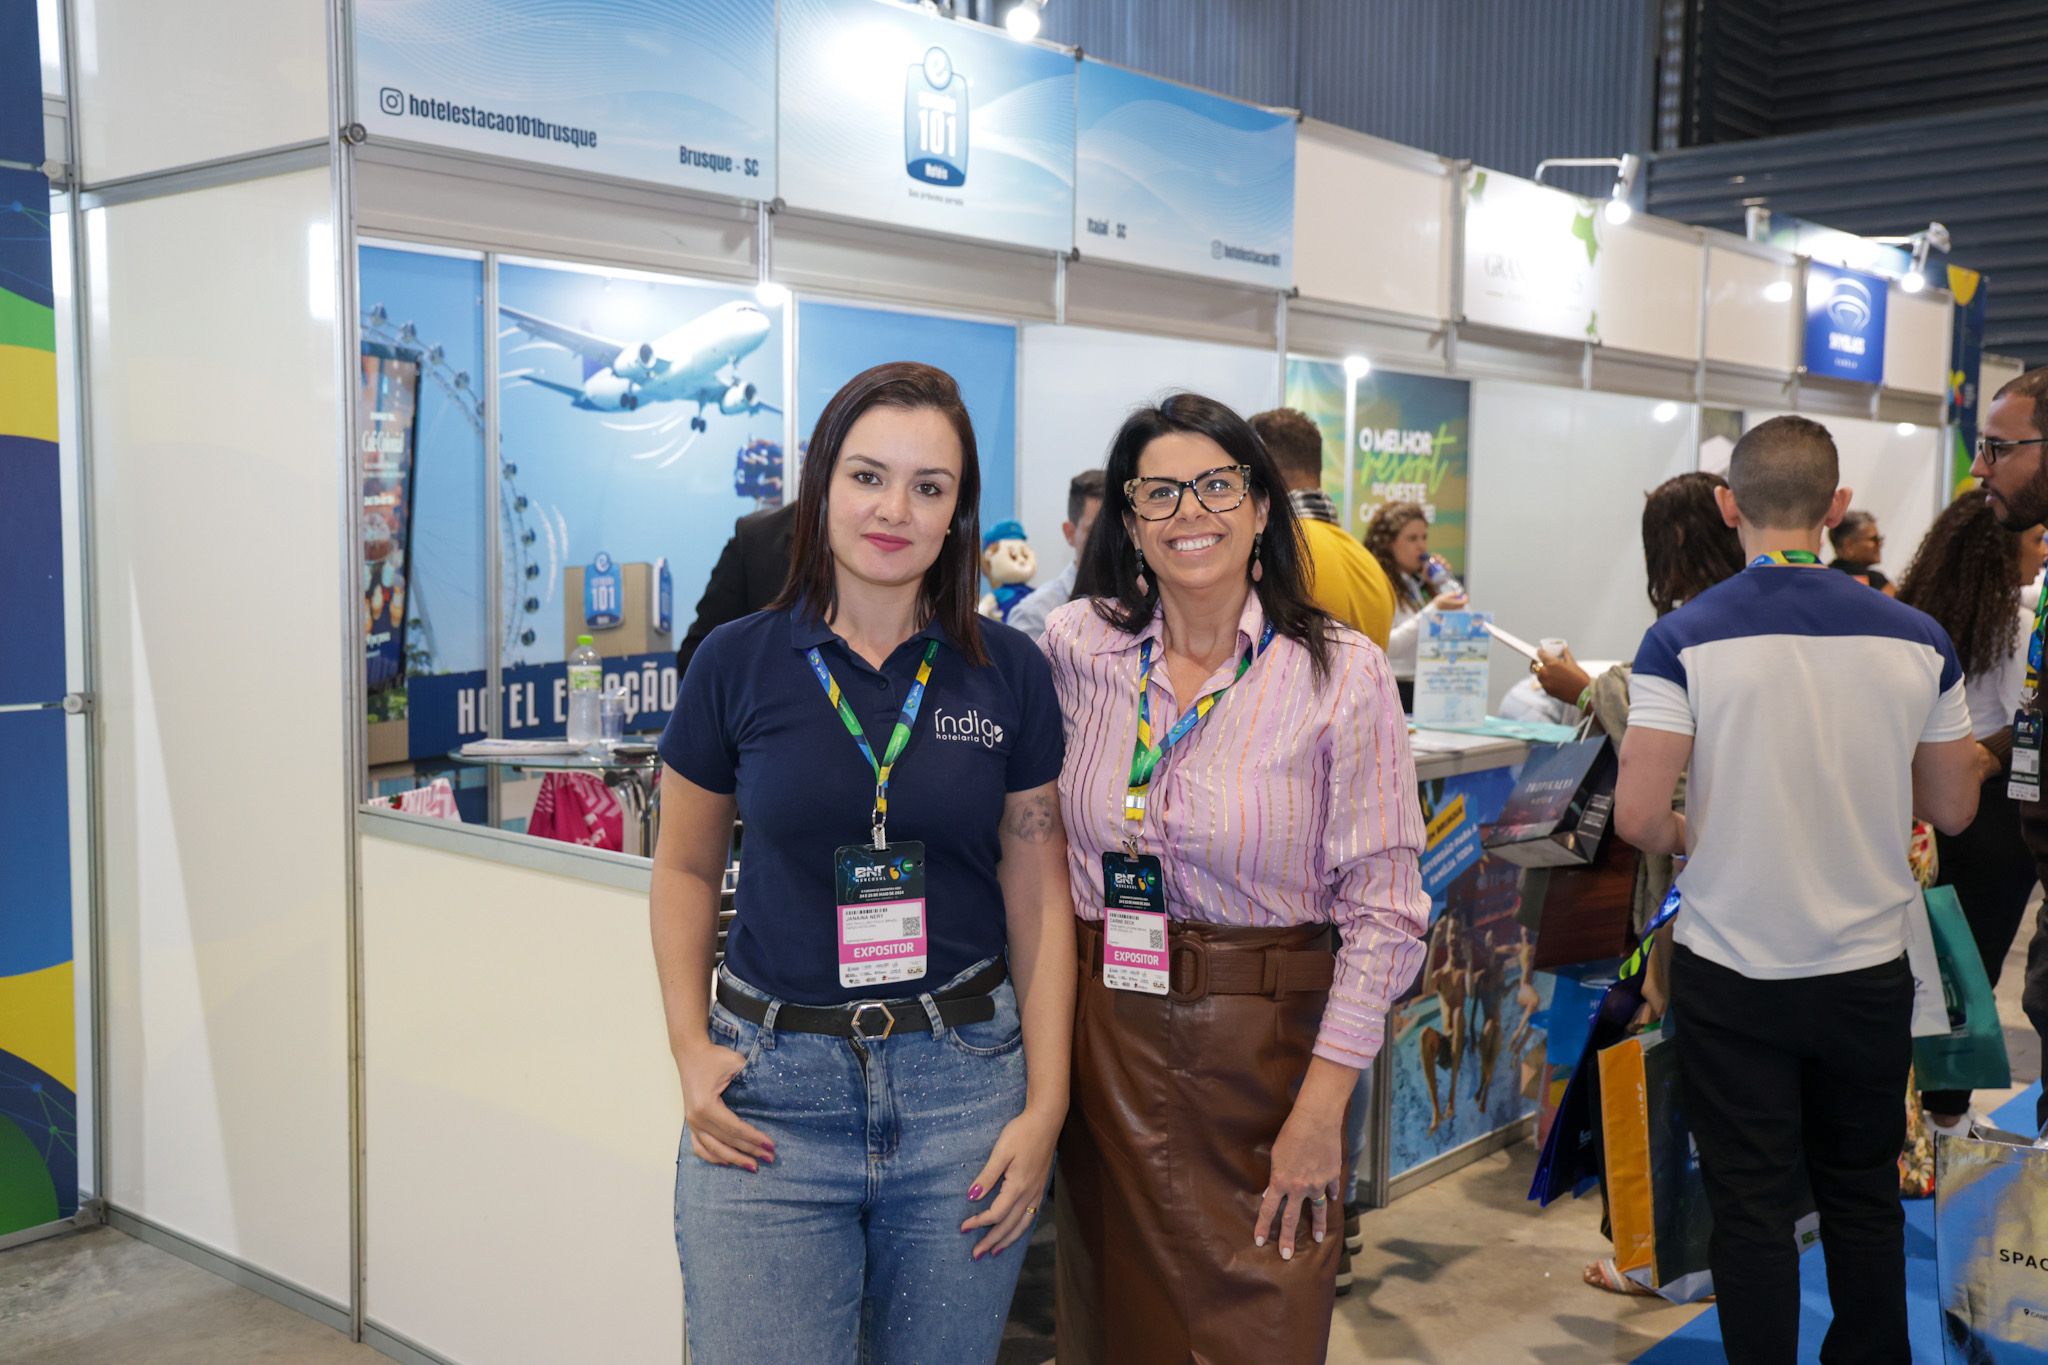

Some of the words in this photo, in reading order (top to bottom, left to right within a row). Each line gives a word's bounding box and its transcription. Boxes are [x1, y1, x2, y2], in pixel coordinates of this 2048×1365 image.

[409, 94, 597, 148] hotelestacao101brusque
[918, 109, 956, 157] 101
[680, 145, 732, 173] Brusque
[744, 157, 759, 177] SC
[1359, 426, 1373, 452] O
[1374, 428, 1433, 456] MELHOR
[592, 586, 615, 612] 101
[936, 732, 980, 742] hotelaria
[854, 865, 886, 878] BNT
[1115, 872, 1136, 885] BNT
[853, 942, 914, 958] EXPOSITOR
[1114, 951, 1159, 966] EXPOSITOR
